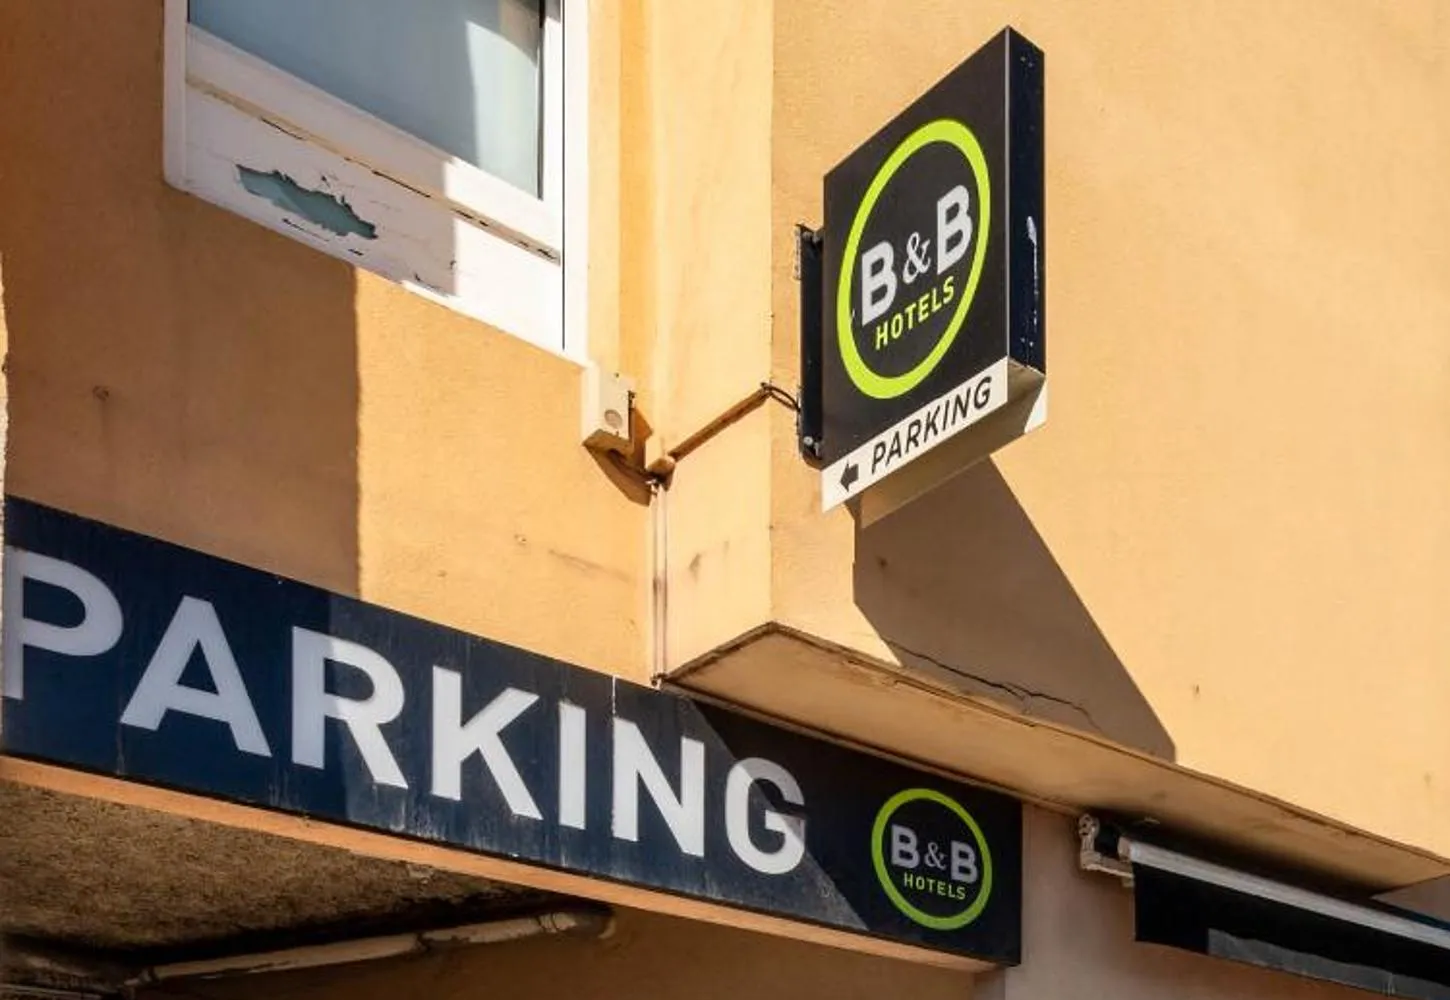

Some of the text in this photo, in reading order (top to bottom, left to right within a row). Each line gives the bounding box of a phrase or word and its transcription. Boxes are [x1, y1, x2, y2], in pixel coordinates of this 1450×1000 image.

[861, 184, 973, 327] B&B
[874, 275, 956, 351] HOTELS
[871, 376, 993, 475] PARKING
[4, 546, 806, 876] PARKING
[892, 824, 978, 884] B&B
[903, 872, 967, 900] HOTELS
